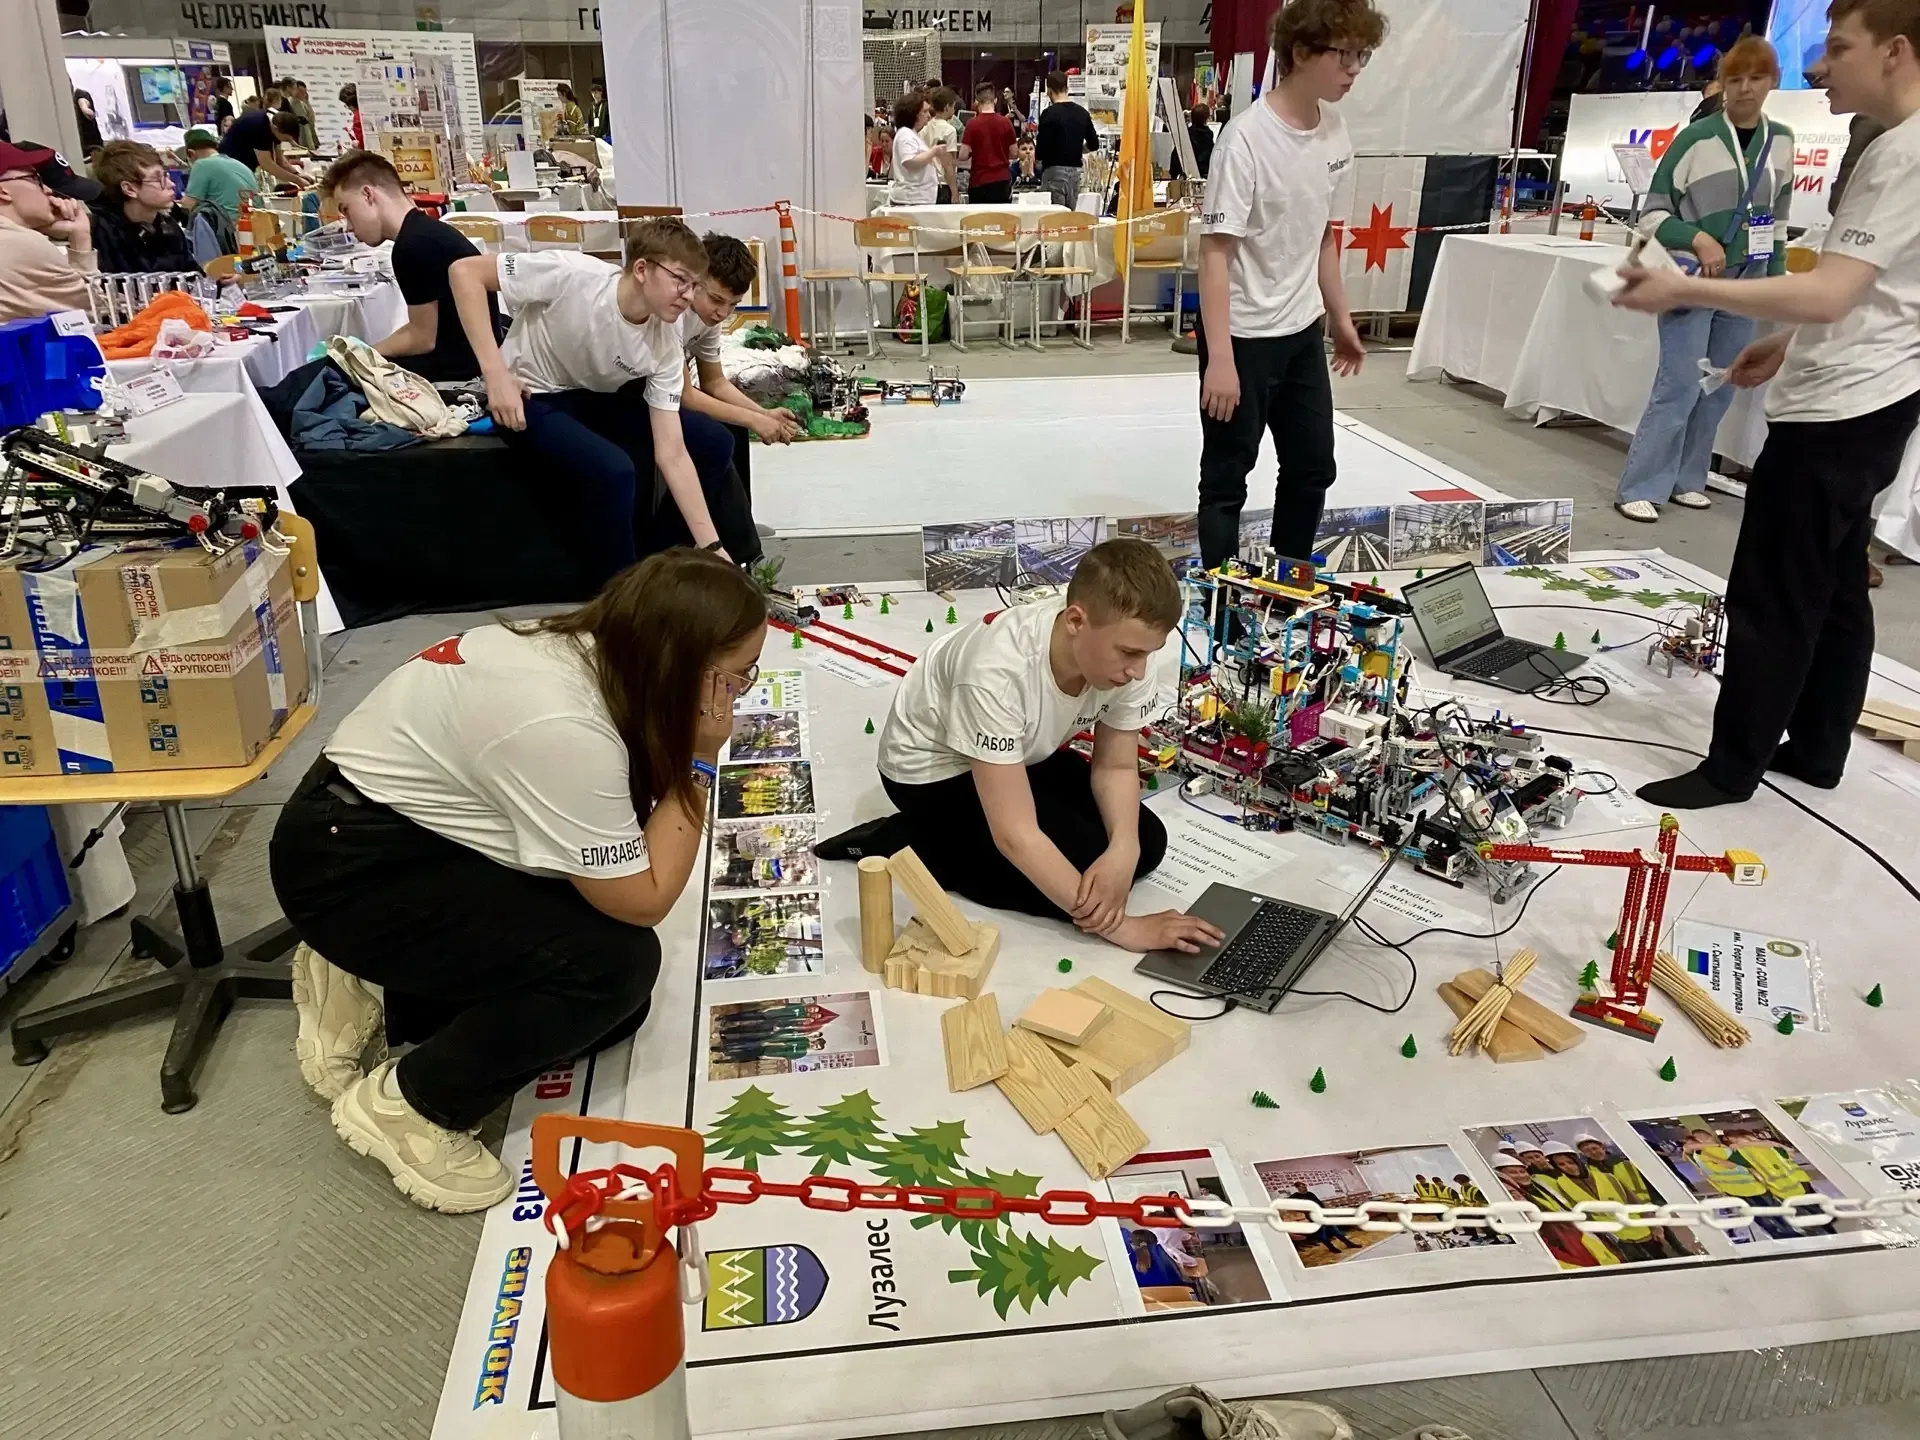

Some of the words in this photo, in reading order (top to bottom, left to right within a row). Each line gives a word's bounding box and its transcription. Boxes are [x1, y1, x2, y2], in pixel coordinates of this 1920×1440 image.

[181, 3, 330, 29] ЧЕЛЯБИНСК
[887, 10, 991, 31] ХОККЕЕМ
[1840, 228, 1875, 246] ЕГОР
[184, 652, 233, 662] ОСТОРОЖЕ
[976, 732, 1015, 752] ГАБОВ
[1375, 887, 1444, 919] анипулятор
[1733, 943, 1744, 971] Георгия
[1710, 950, 1722, 991] Сыктывкара
[1845, 1117, 1894, 1128] Лузалес
[866, 1218, 907, 1332] Лузалес
[473, 1247, 532, 1411] ЗНАТОК
